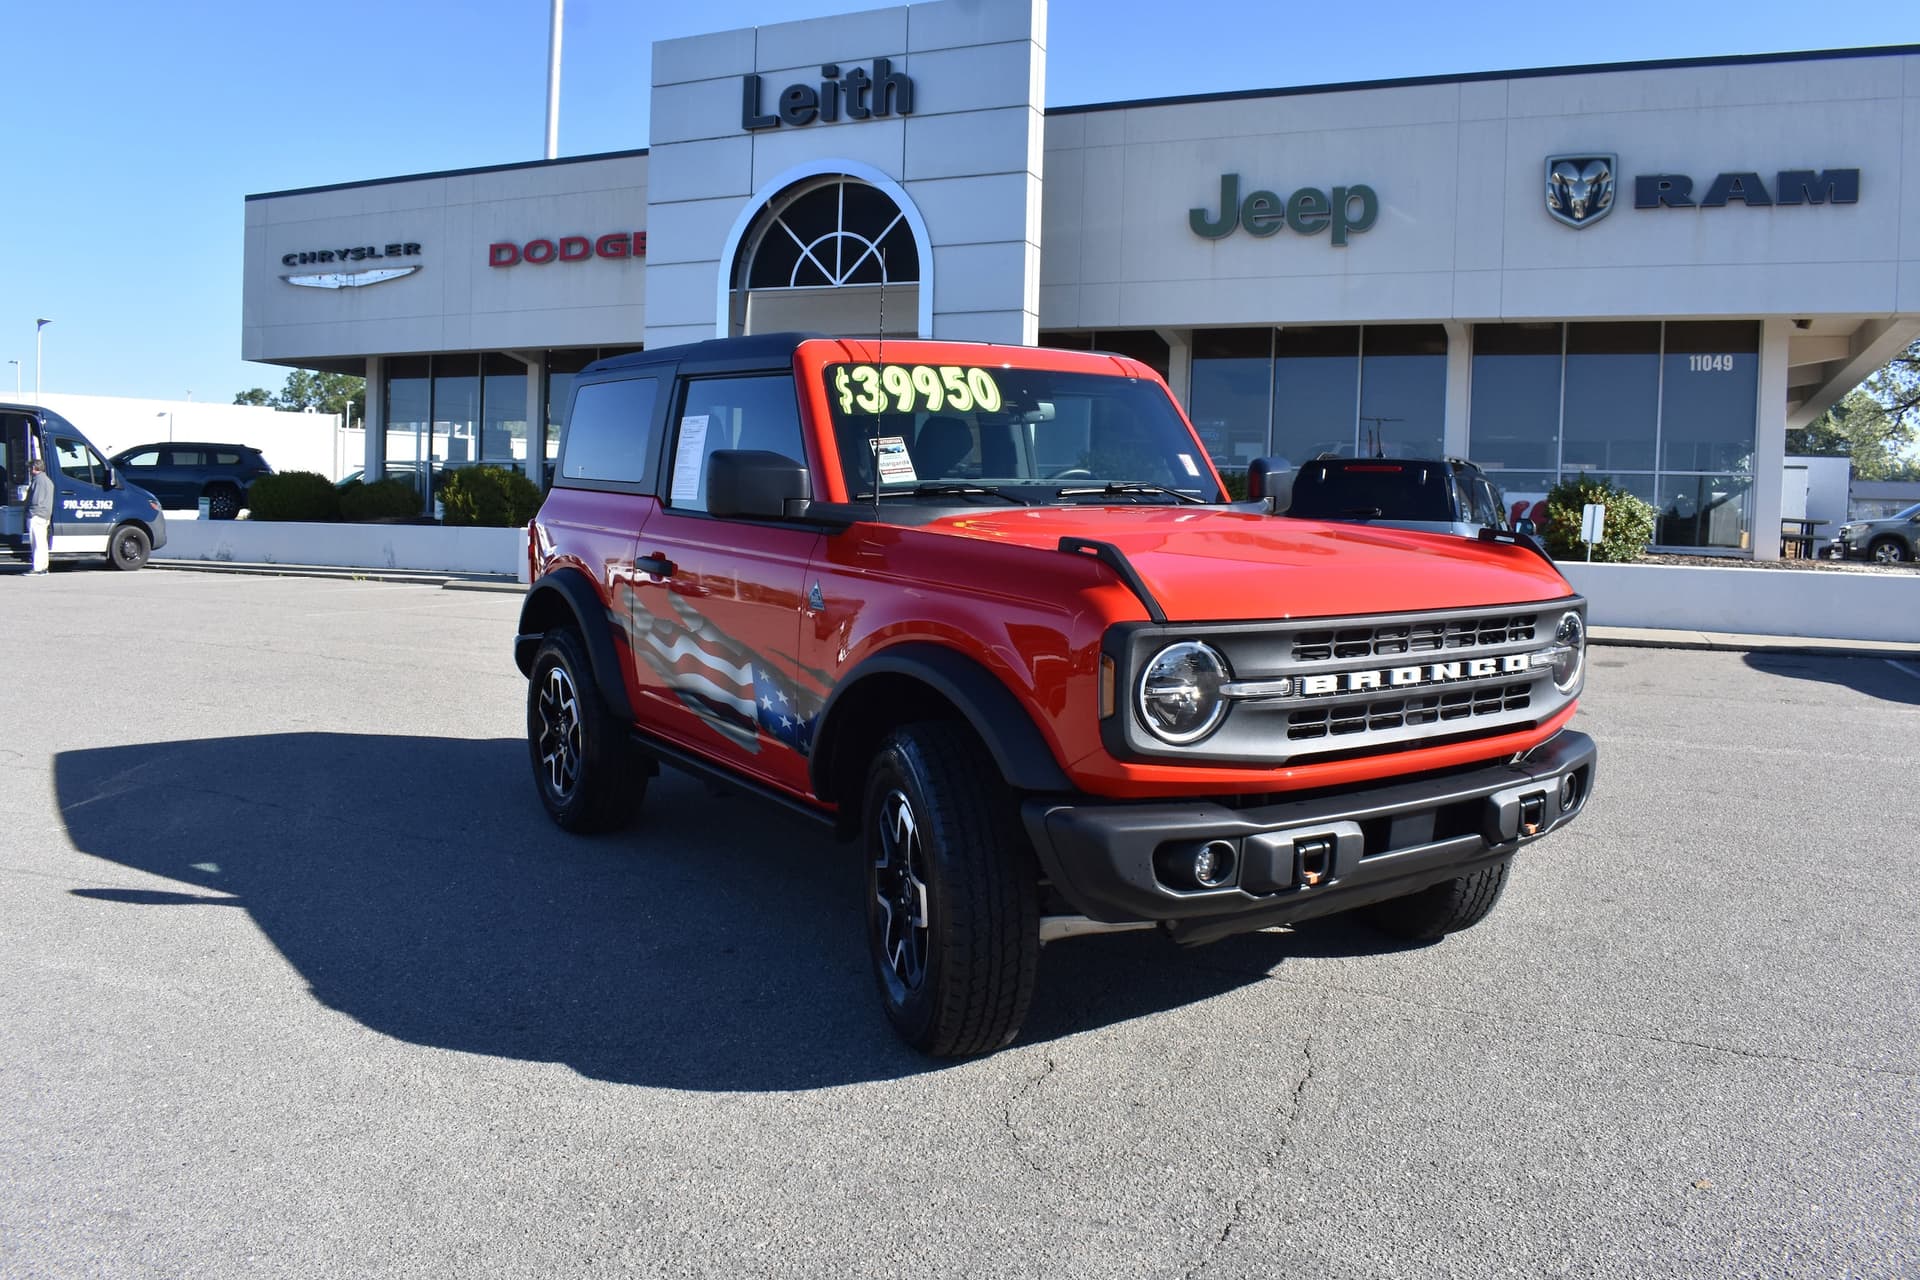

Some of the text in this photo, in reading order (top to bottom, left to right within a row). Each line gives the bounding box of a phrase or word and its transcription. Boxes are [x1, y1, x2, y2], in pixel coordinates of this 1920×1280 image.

[742, 57, 914, 131] Leith
[1189, 172, 1379, 247] Jeep
[1634, 168, 1860, 209] RAM
[281, 242, 422, 267] CHRYSLER
[1689, 354, 1733, 371] 11049
[835, 365, 1001, 415] $39950
[1302, 652, 1530, 695] BRONCO
